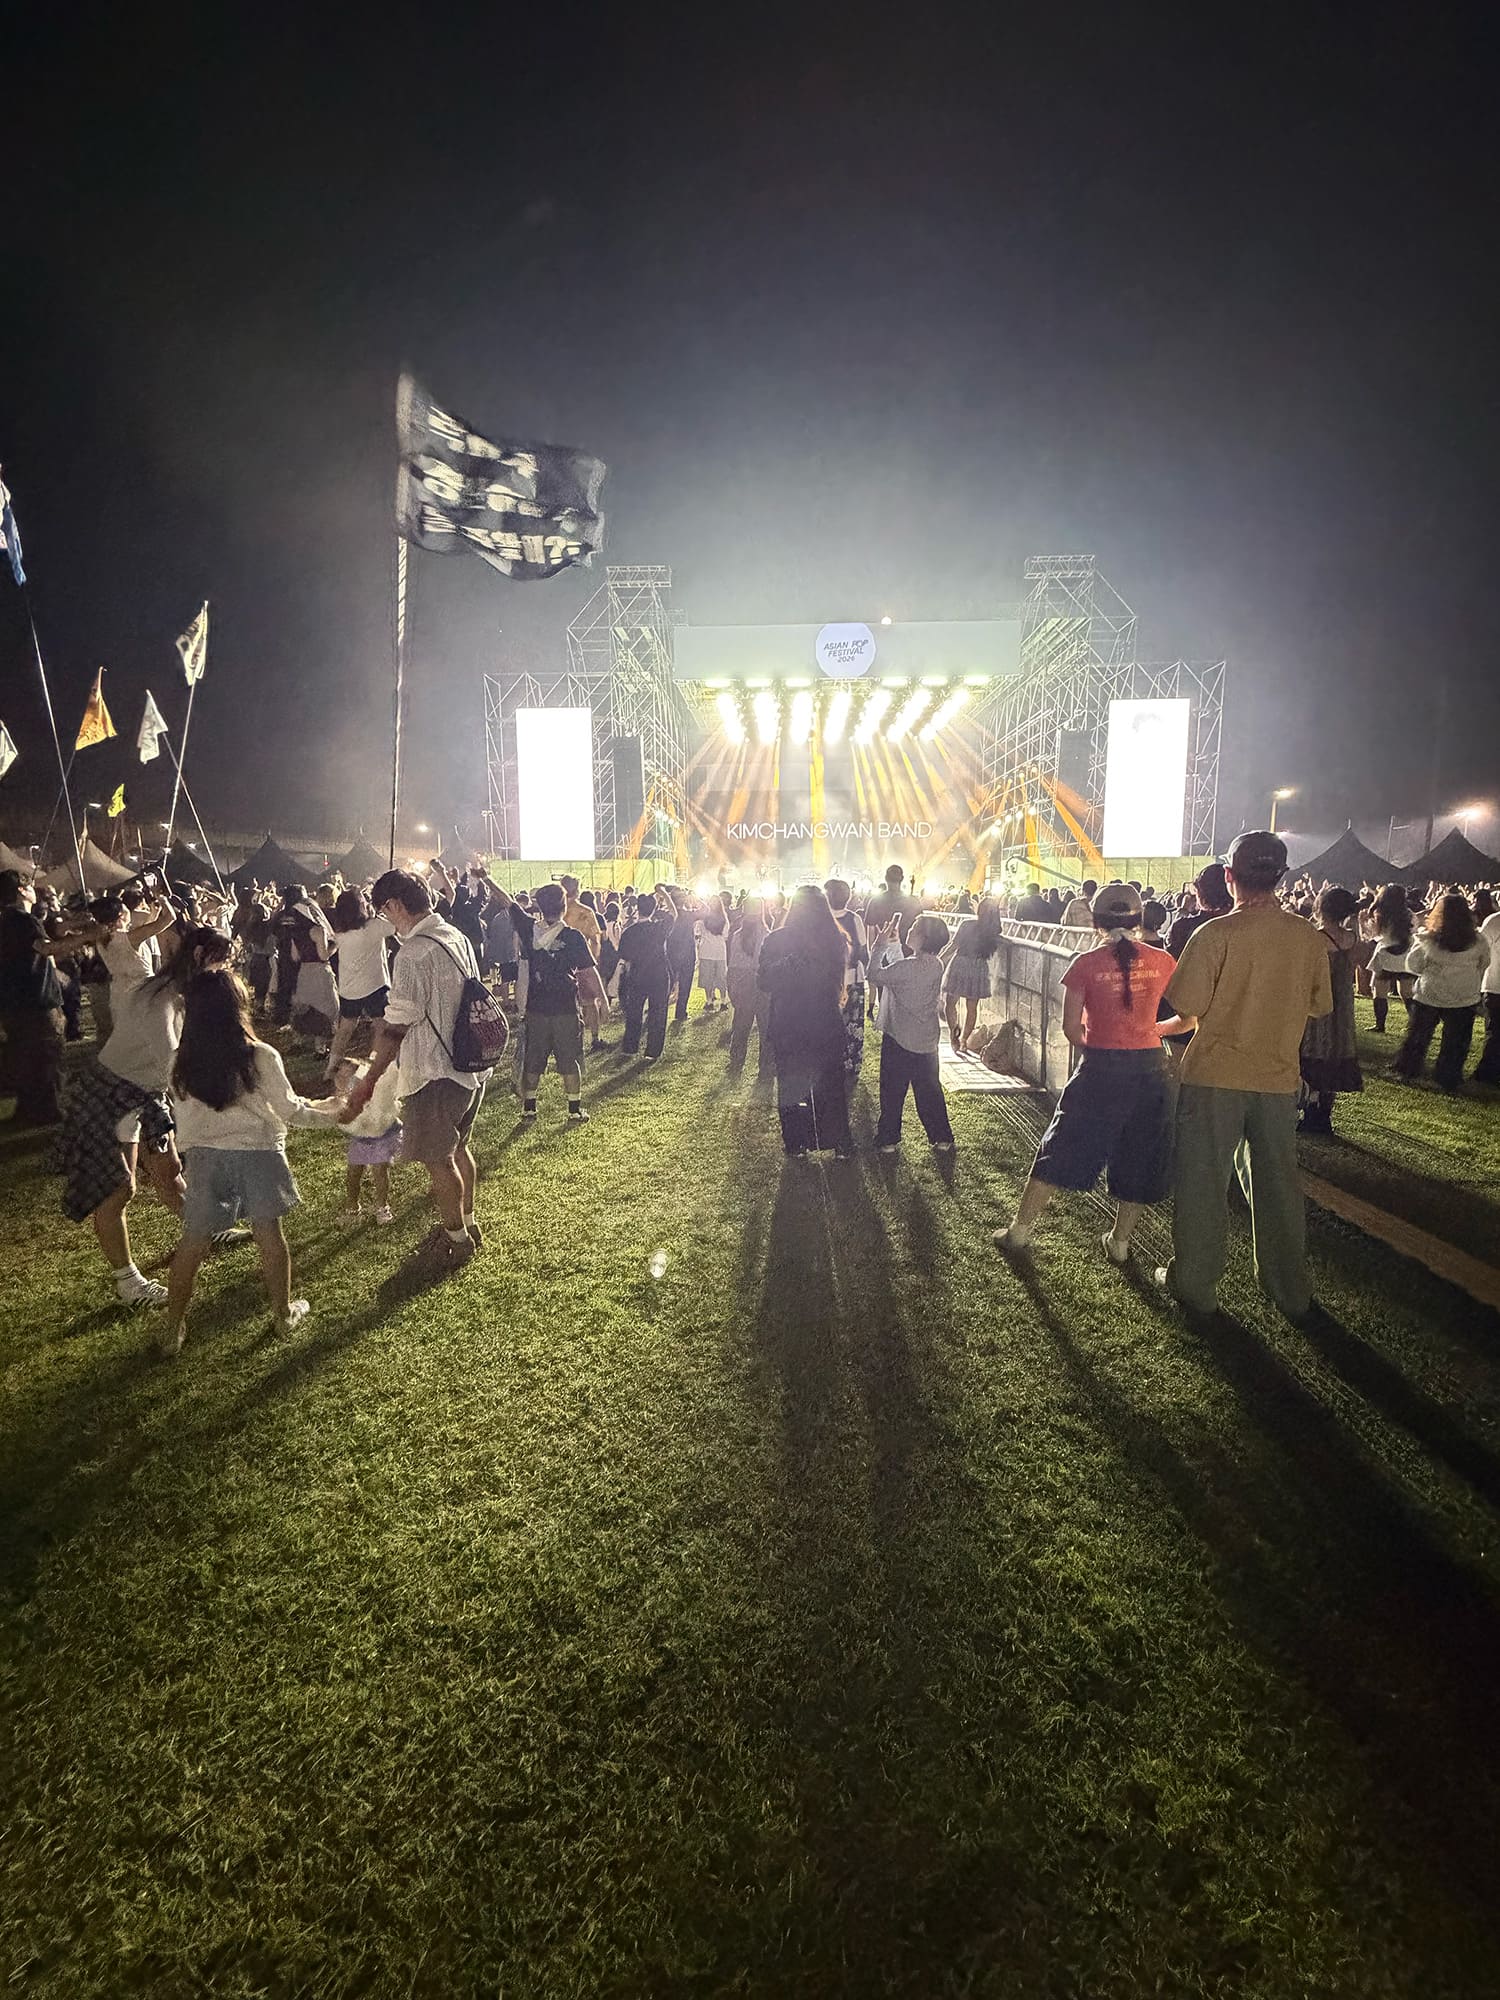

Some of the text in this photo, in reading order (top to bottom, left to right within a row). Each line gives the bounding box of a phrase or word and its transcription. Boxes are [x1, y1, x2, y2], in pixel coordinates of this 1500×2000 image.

[824, 640, 868, 650] ASIAN POP
[827, 647, 864, 657] FESTIVAL
[726, 822, 933, 840] KIMCHANGWAN BAND
